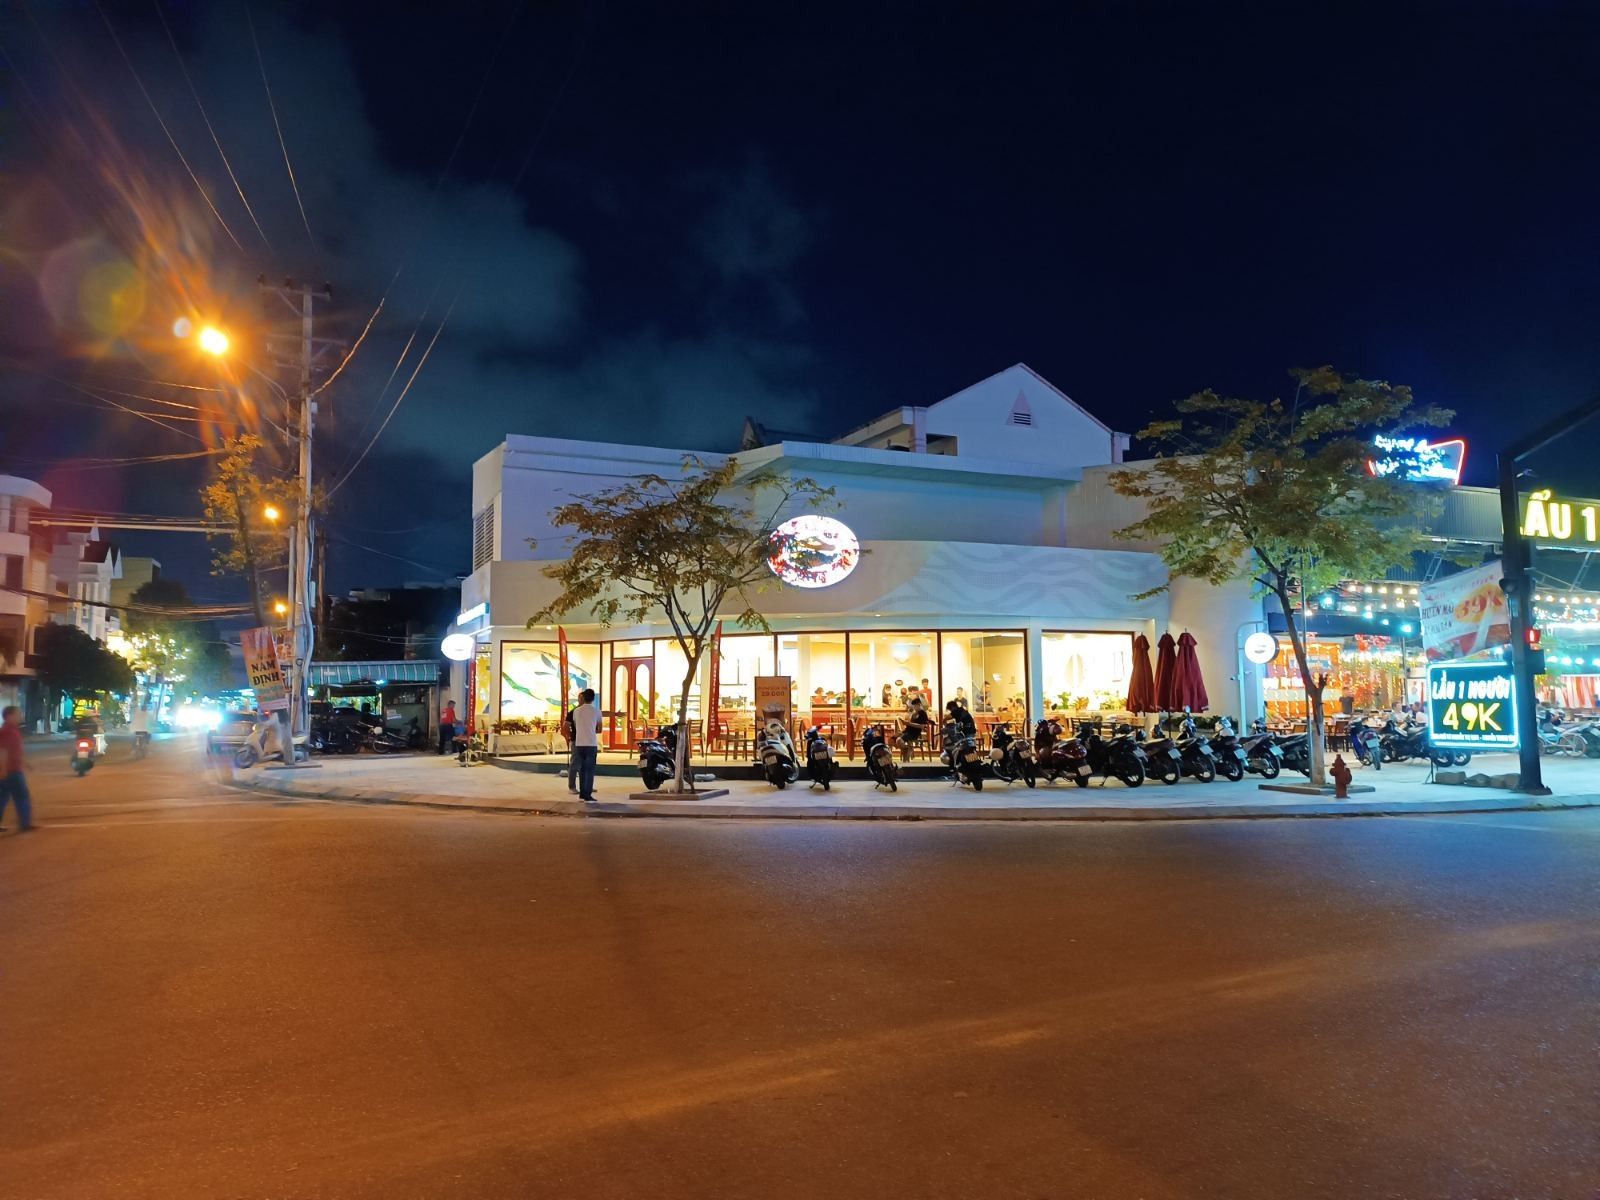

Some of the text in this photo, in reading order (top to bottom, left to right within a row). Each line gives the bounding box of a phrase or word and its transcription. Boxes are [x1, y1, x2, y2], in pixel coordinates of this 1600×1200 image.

[1520, 489, 1596, 541] ẨU 1
[1458, 680, 1465, 699] 1
[1442, 702, 1502, 731] 49K
